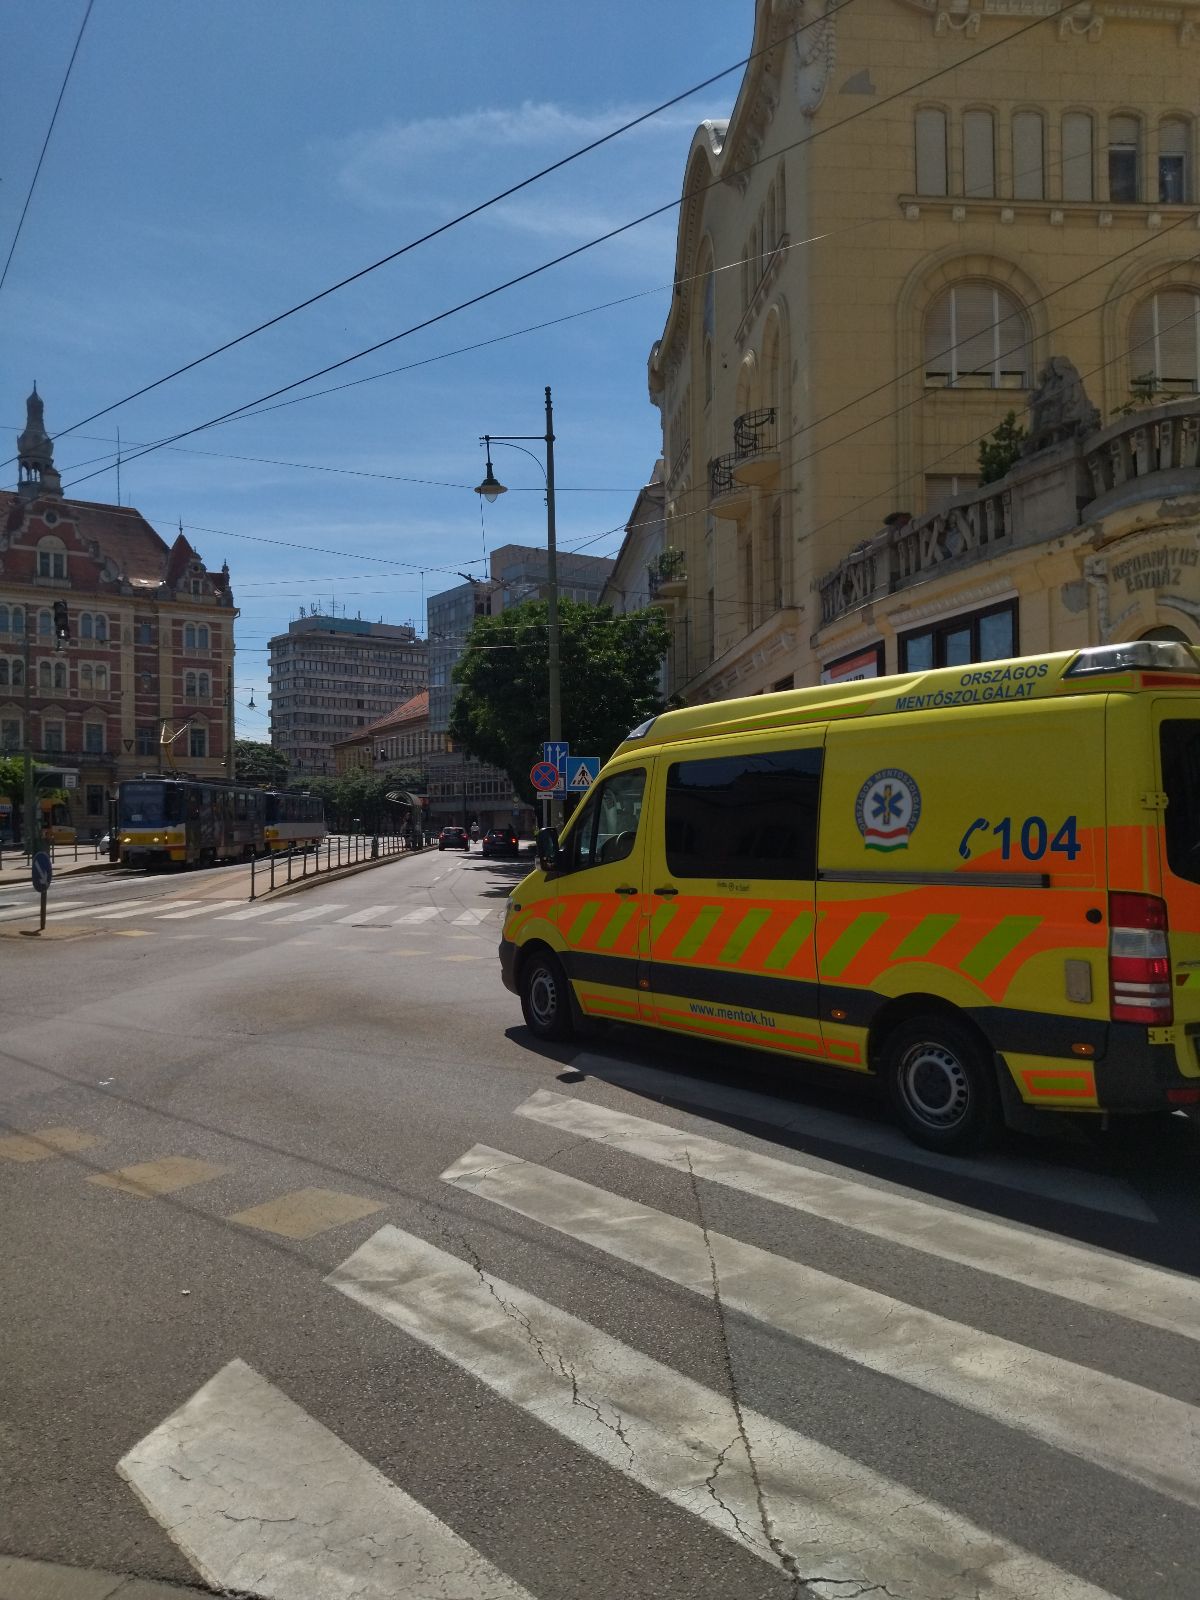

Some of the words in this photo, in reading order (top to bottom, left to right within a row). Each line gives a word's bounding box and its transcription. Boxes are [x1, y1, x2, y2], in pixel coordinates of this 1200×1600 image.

[960, 663, 1048, 687] ORSZÁGOS
[895, 681, 1036, 710] MENTŐSZOLGÁLAT
[993, 815, 1082, 861] 104
[689, 1002, 777, 1027] www.mentok.hu
